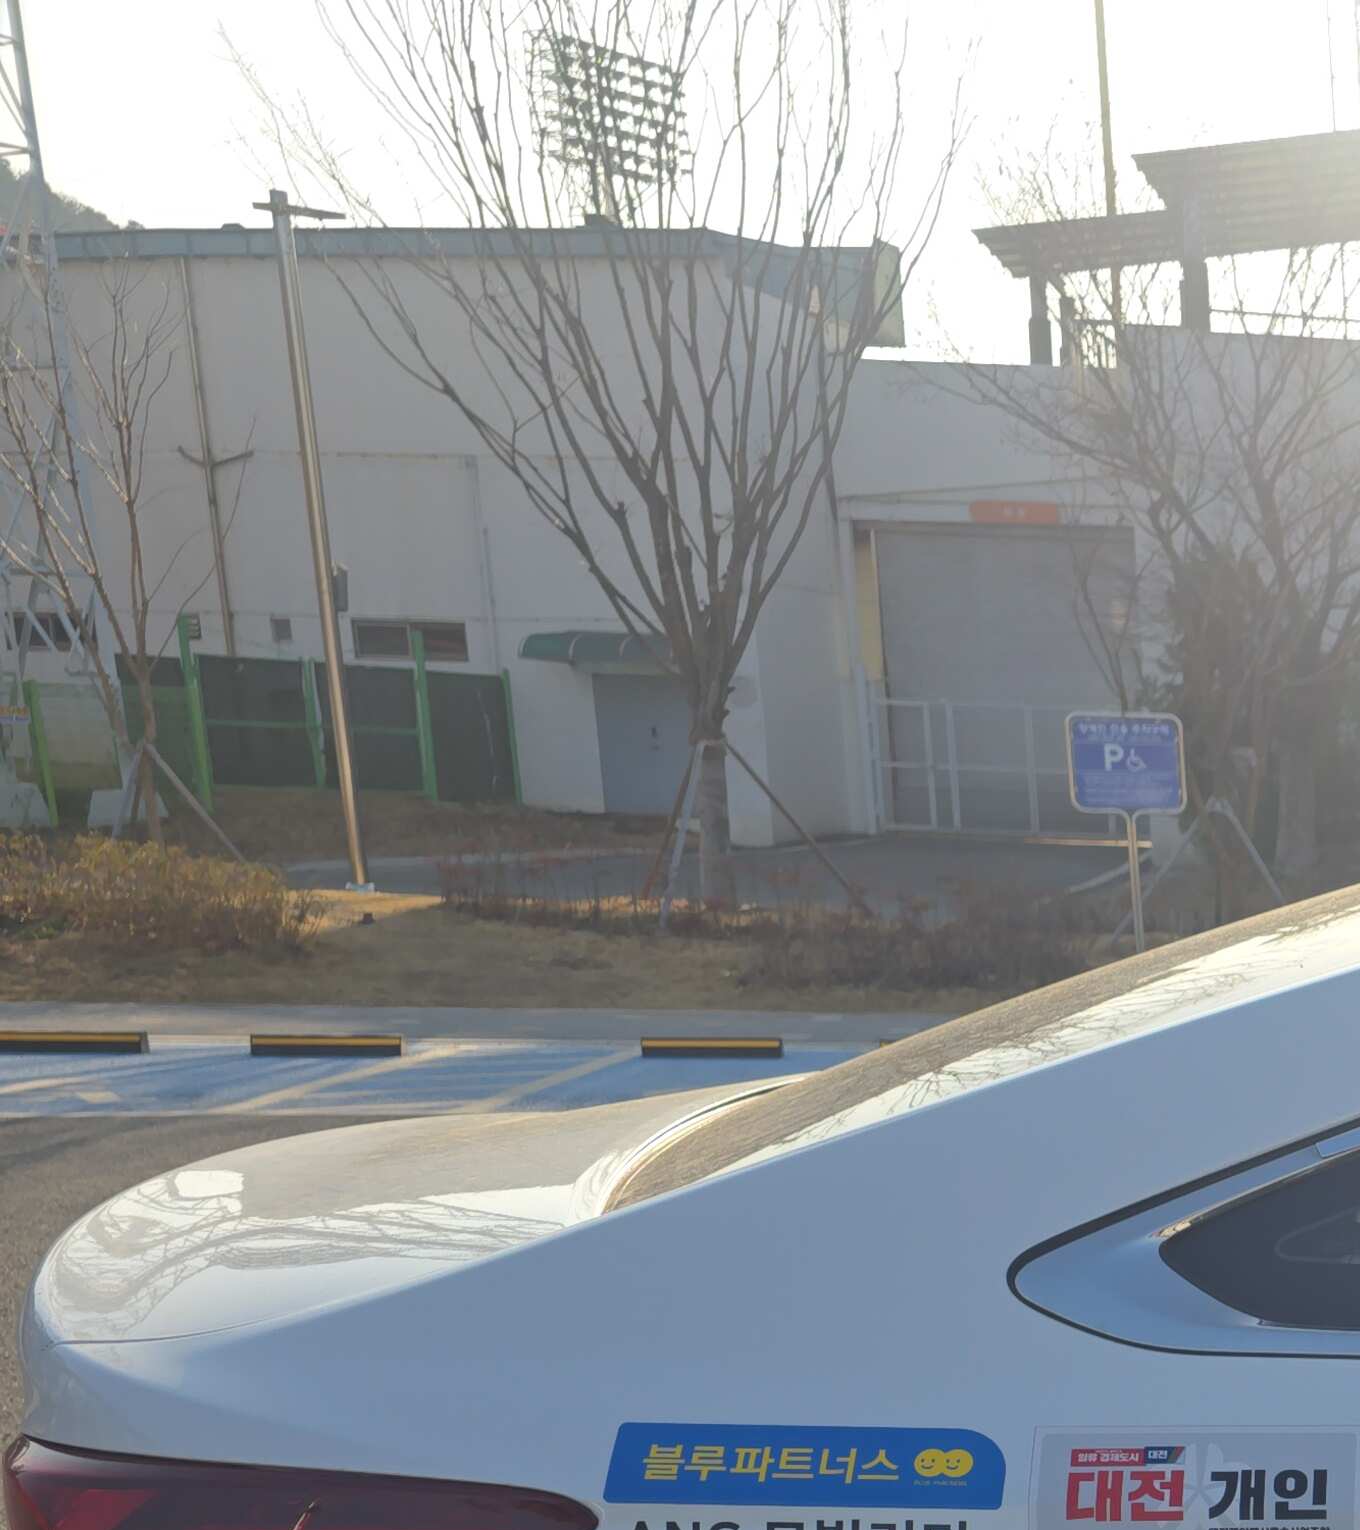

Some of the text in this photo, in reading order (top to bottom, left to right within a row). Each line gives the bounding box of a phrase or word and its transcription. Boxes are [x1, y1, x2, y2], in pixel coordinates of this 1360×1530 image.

[1103, 743, 1124, 771] P
[642, 1443, 899, 1484] 블루파트너스
[1066, 1469, 1328, 1522] 대전 개인
